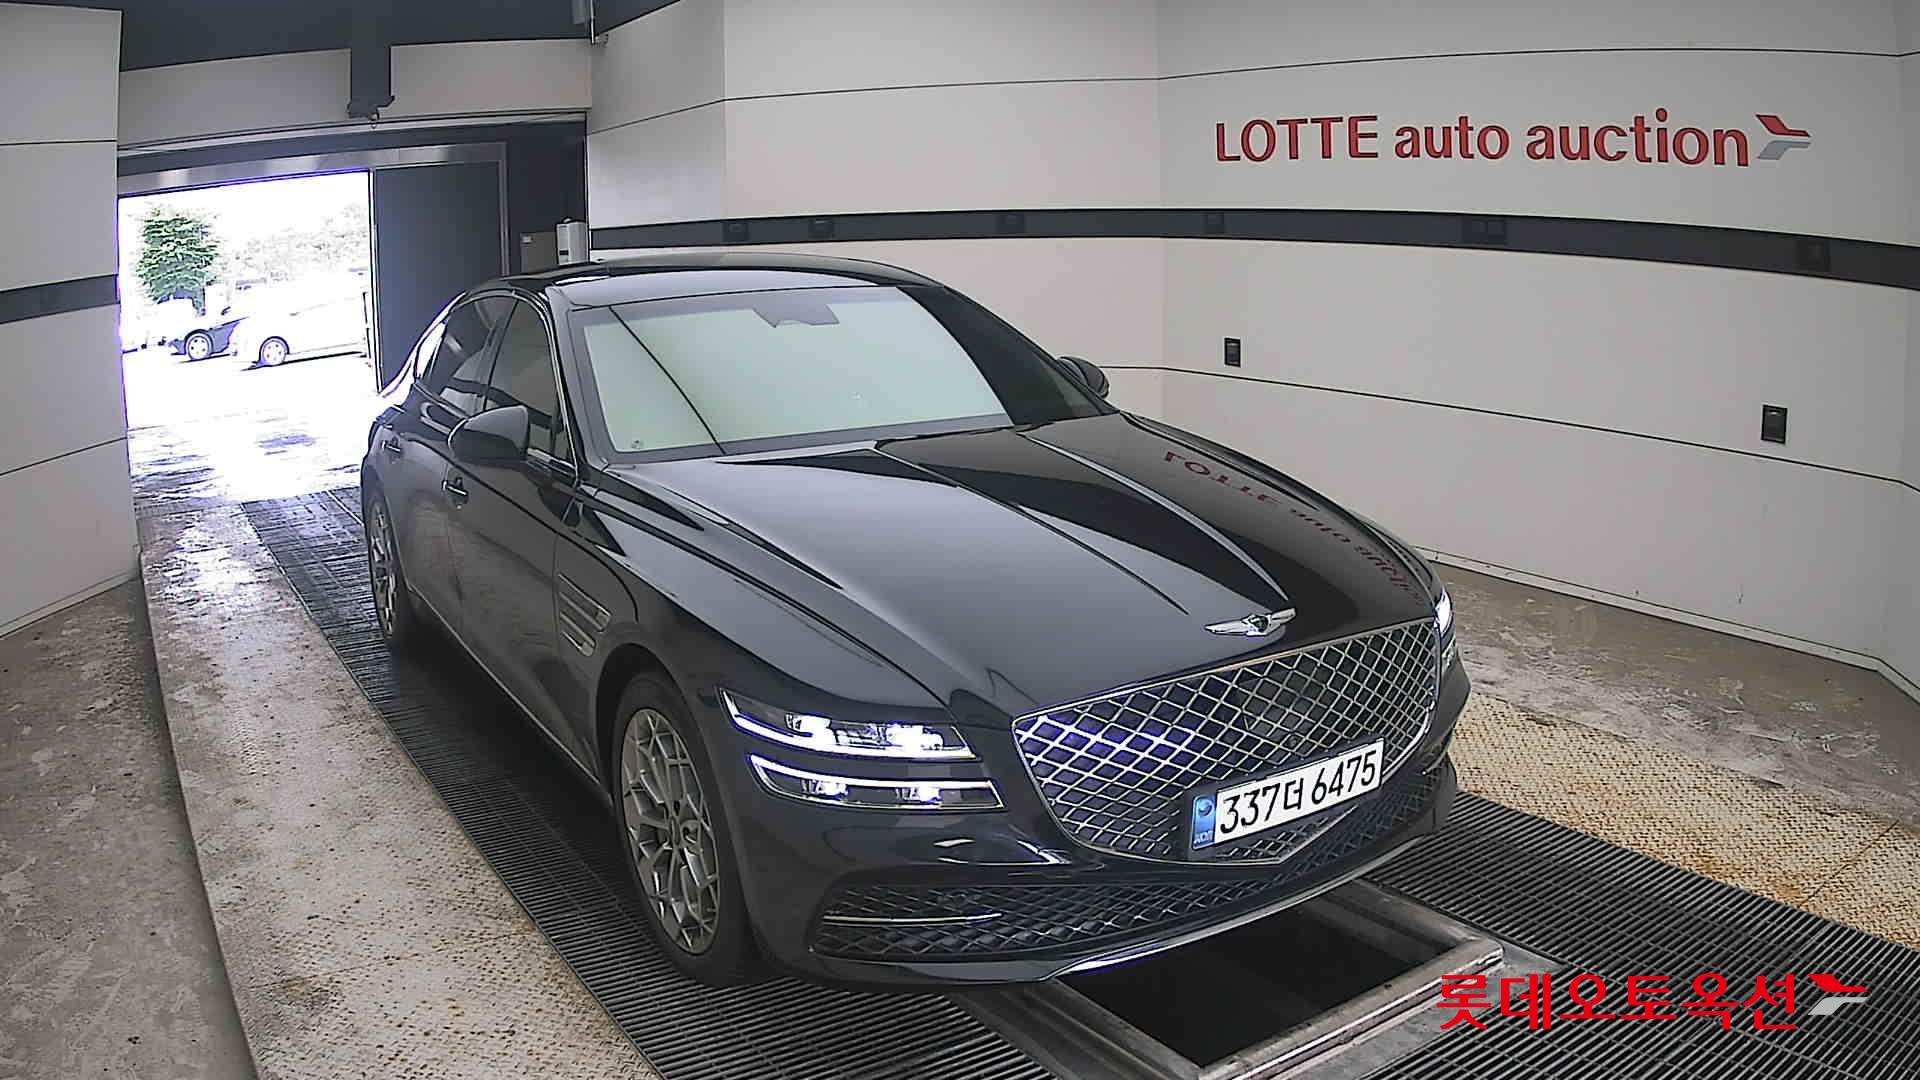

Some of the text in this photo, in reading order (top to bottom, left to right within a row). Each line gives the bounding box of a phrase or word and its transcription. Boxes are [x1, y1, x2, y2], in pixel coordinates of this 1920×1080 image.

[1216, 109, 1749, 167] LOTTE auto auction
[1220, 750, 1376, 833] 337더 6475
